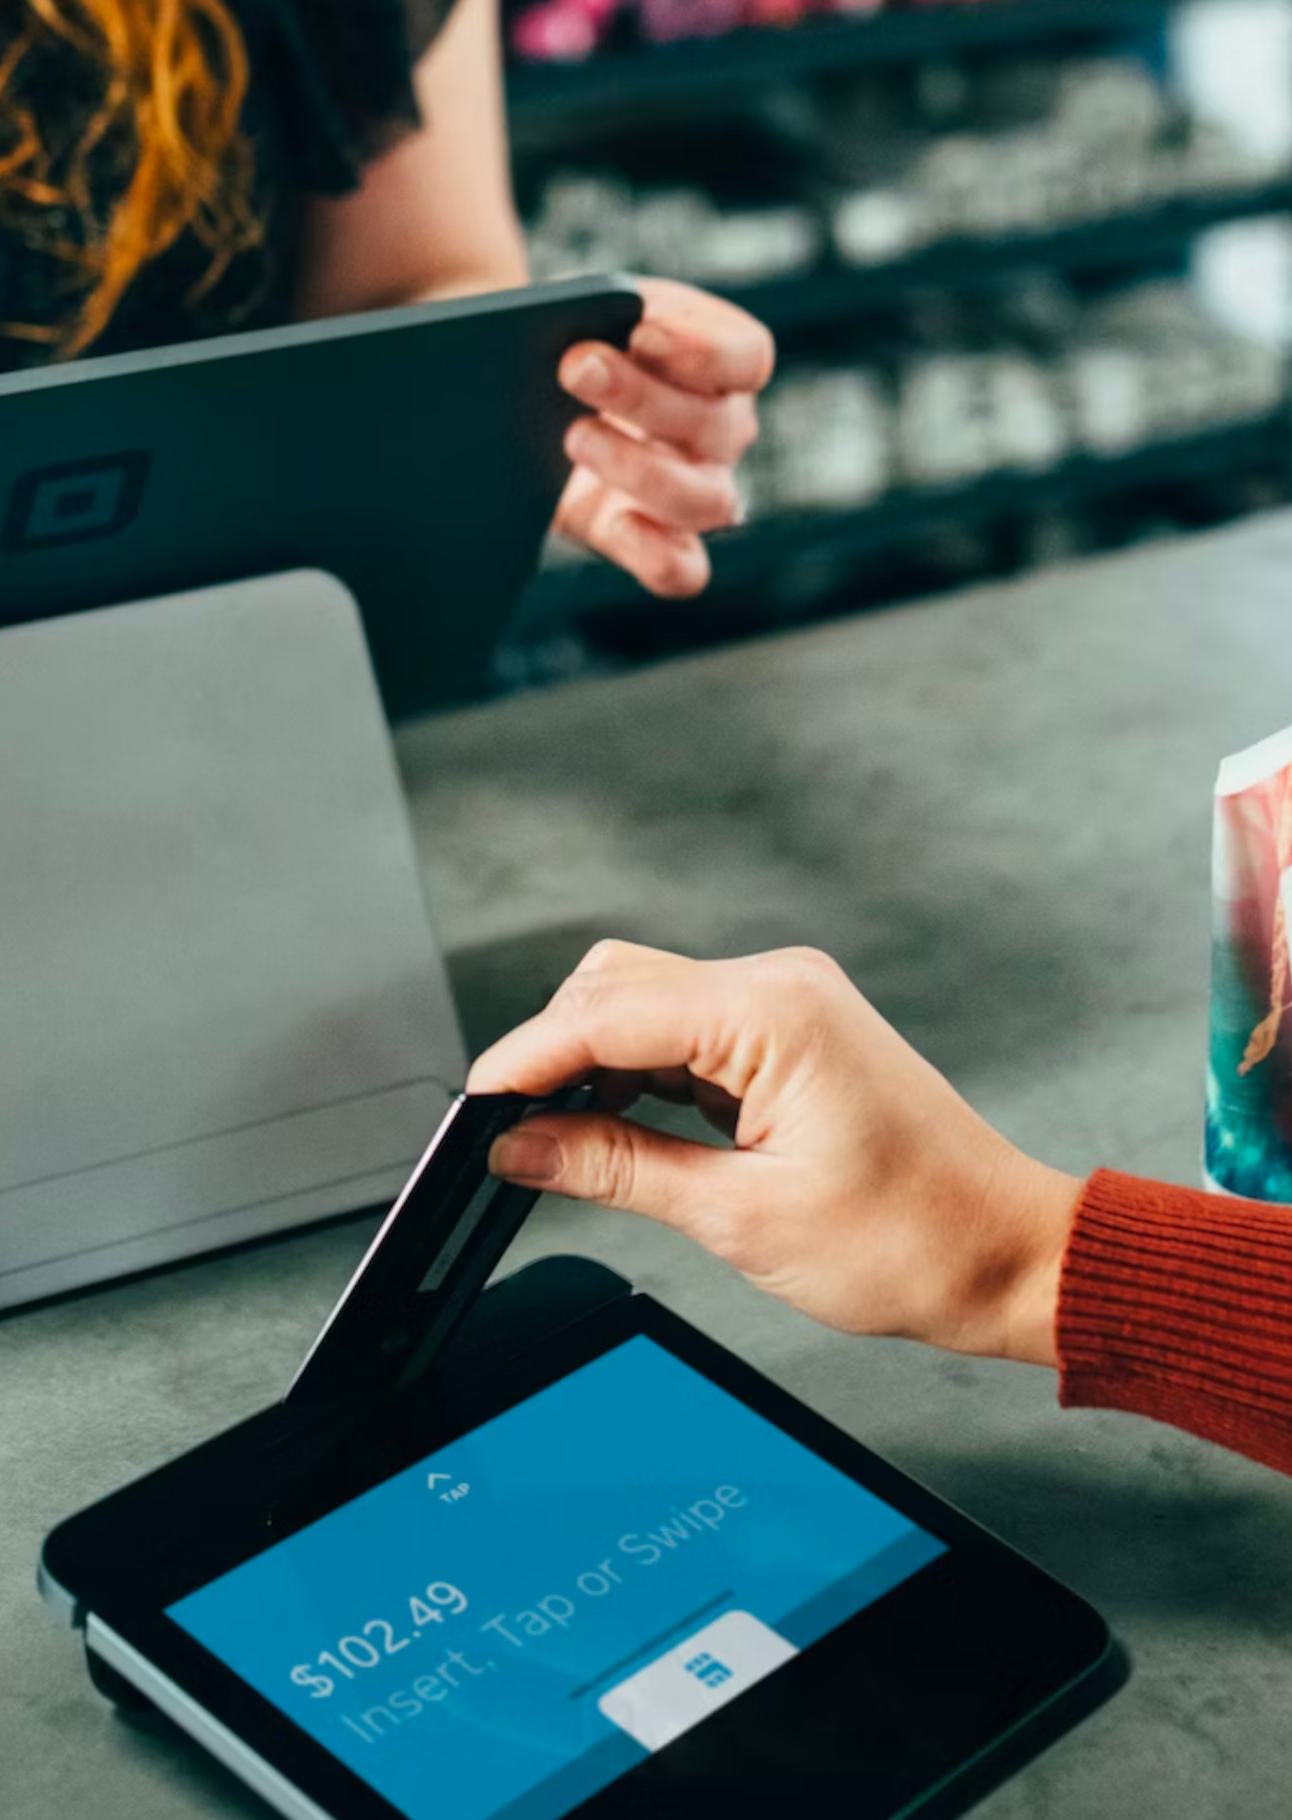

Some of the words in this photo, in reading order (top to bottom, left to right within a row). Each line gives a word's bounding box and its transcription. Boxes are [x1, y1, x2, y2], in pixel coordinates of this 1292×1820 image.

[439, 1482, 470, 1504] TAP
[290, 1581, 469, 1698] $102.49
[337, 1648, 498, 1744] Insert,
[481, 1593, 575, 1649] Tap
[577, 1557, 623, 1597] or
[618, 1484, 748, 1566] Swipe
